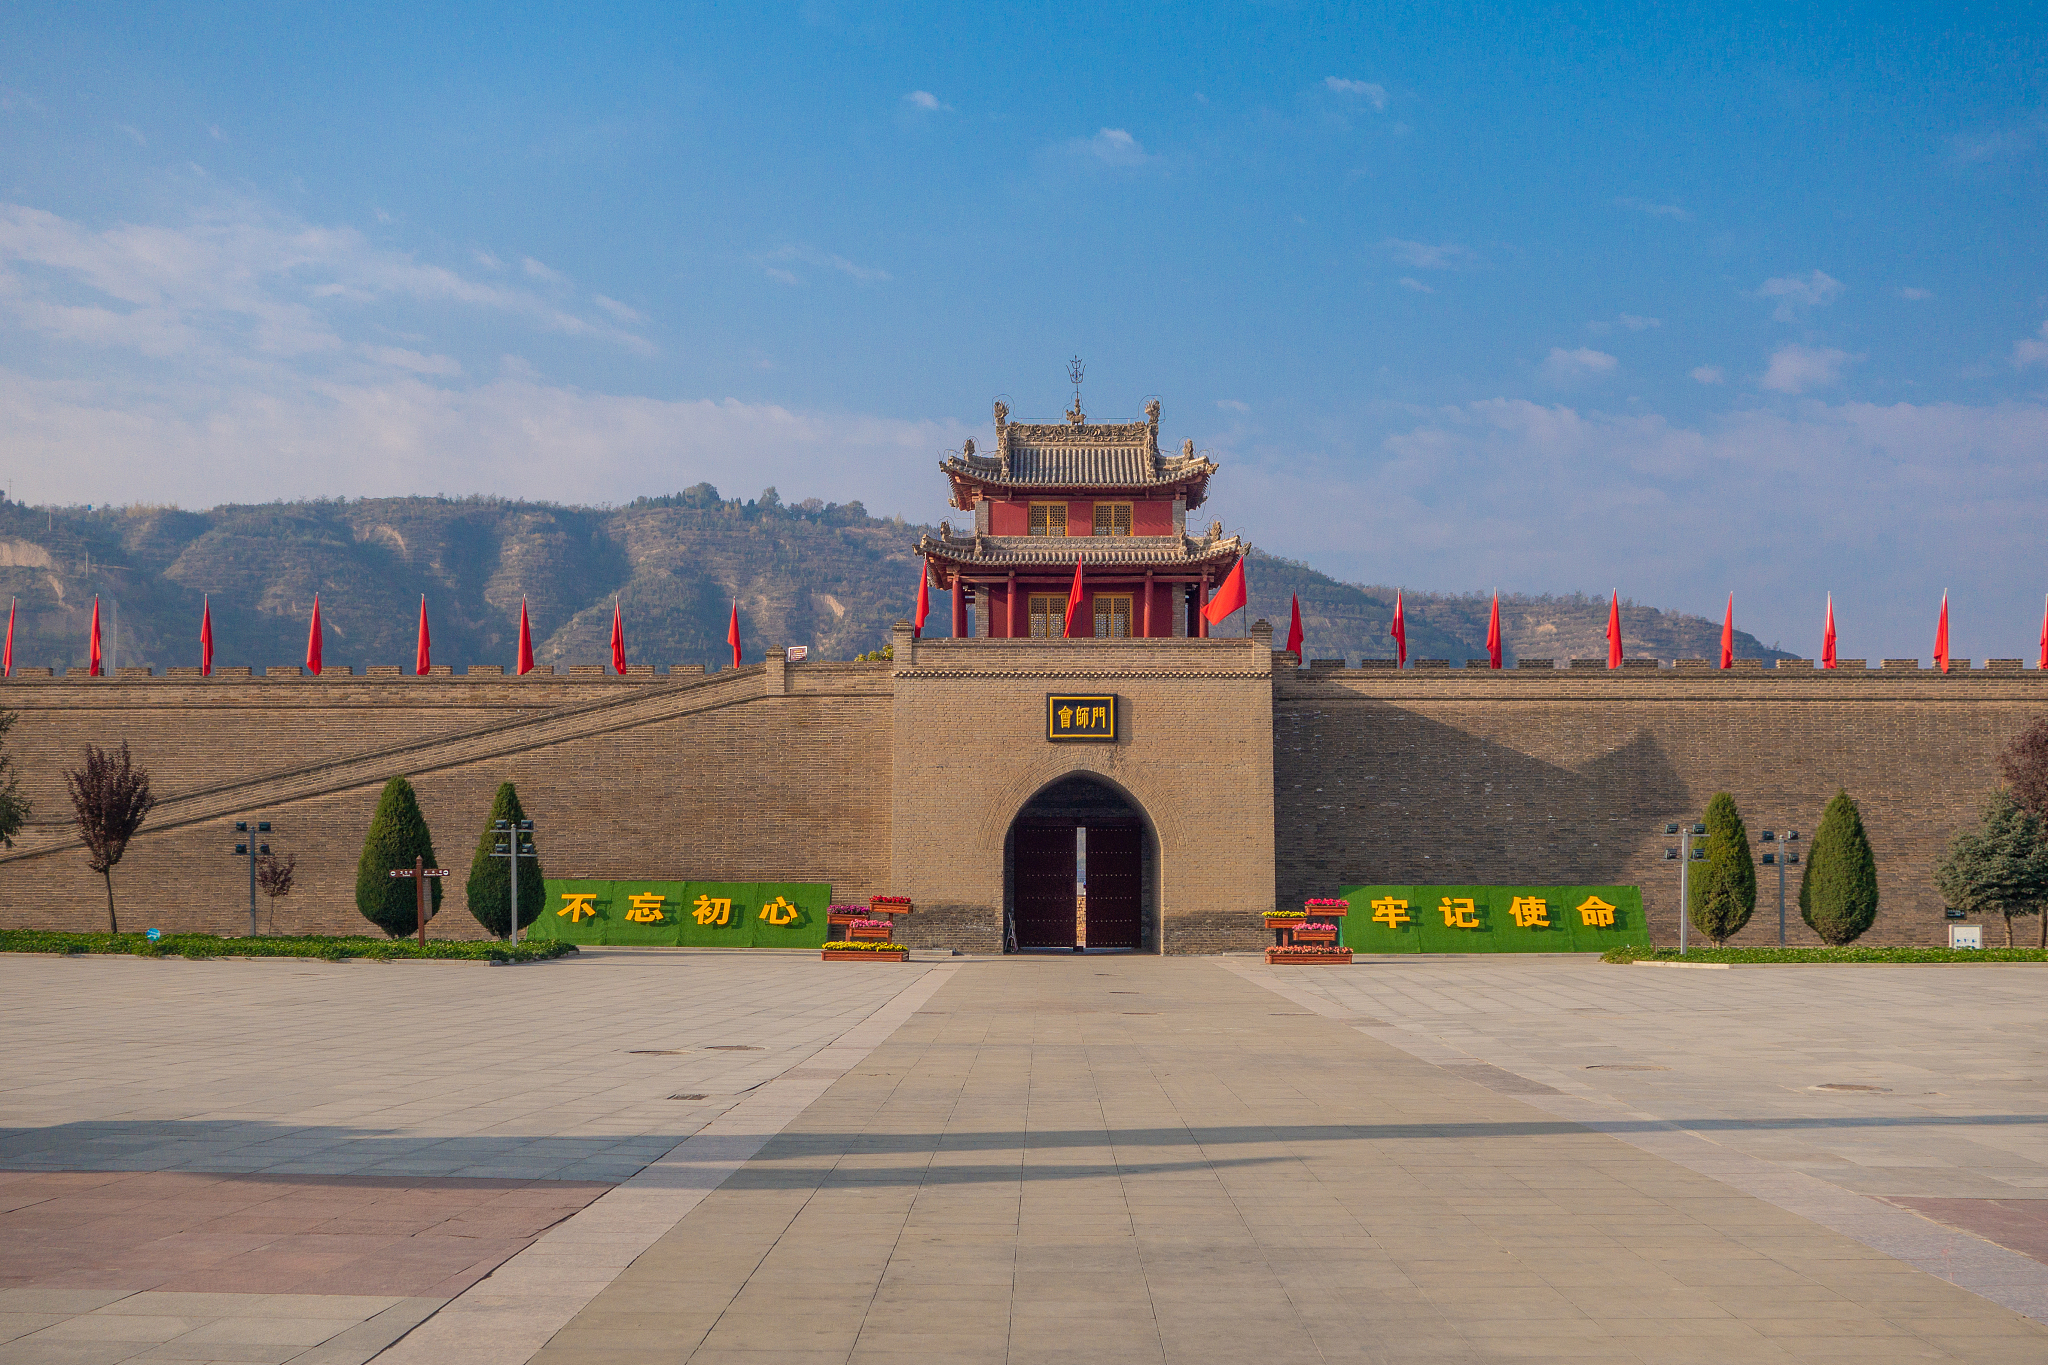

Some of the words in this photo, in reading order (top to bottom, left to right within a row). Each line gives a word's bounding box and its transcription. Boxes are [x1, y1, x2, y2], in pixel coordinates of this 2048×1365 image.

[1057, 705, 1106, 729] 會師門
[556, 892, 798, 925] 不忘初心
[1370, 896, 1617, 928] 牢记使命
